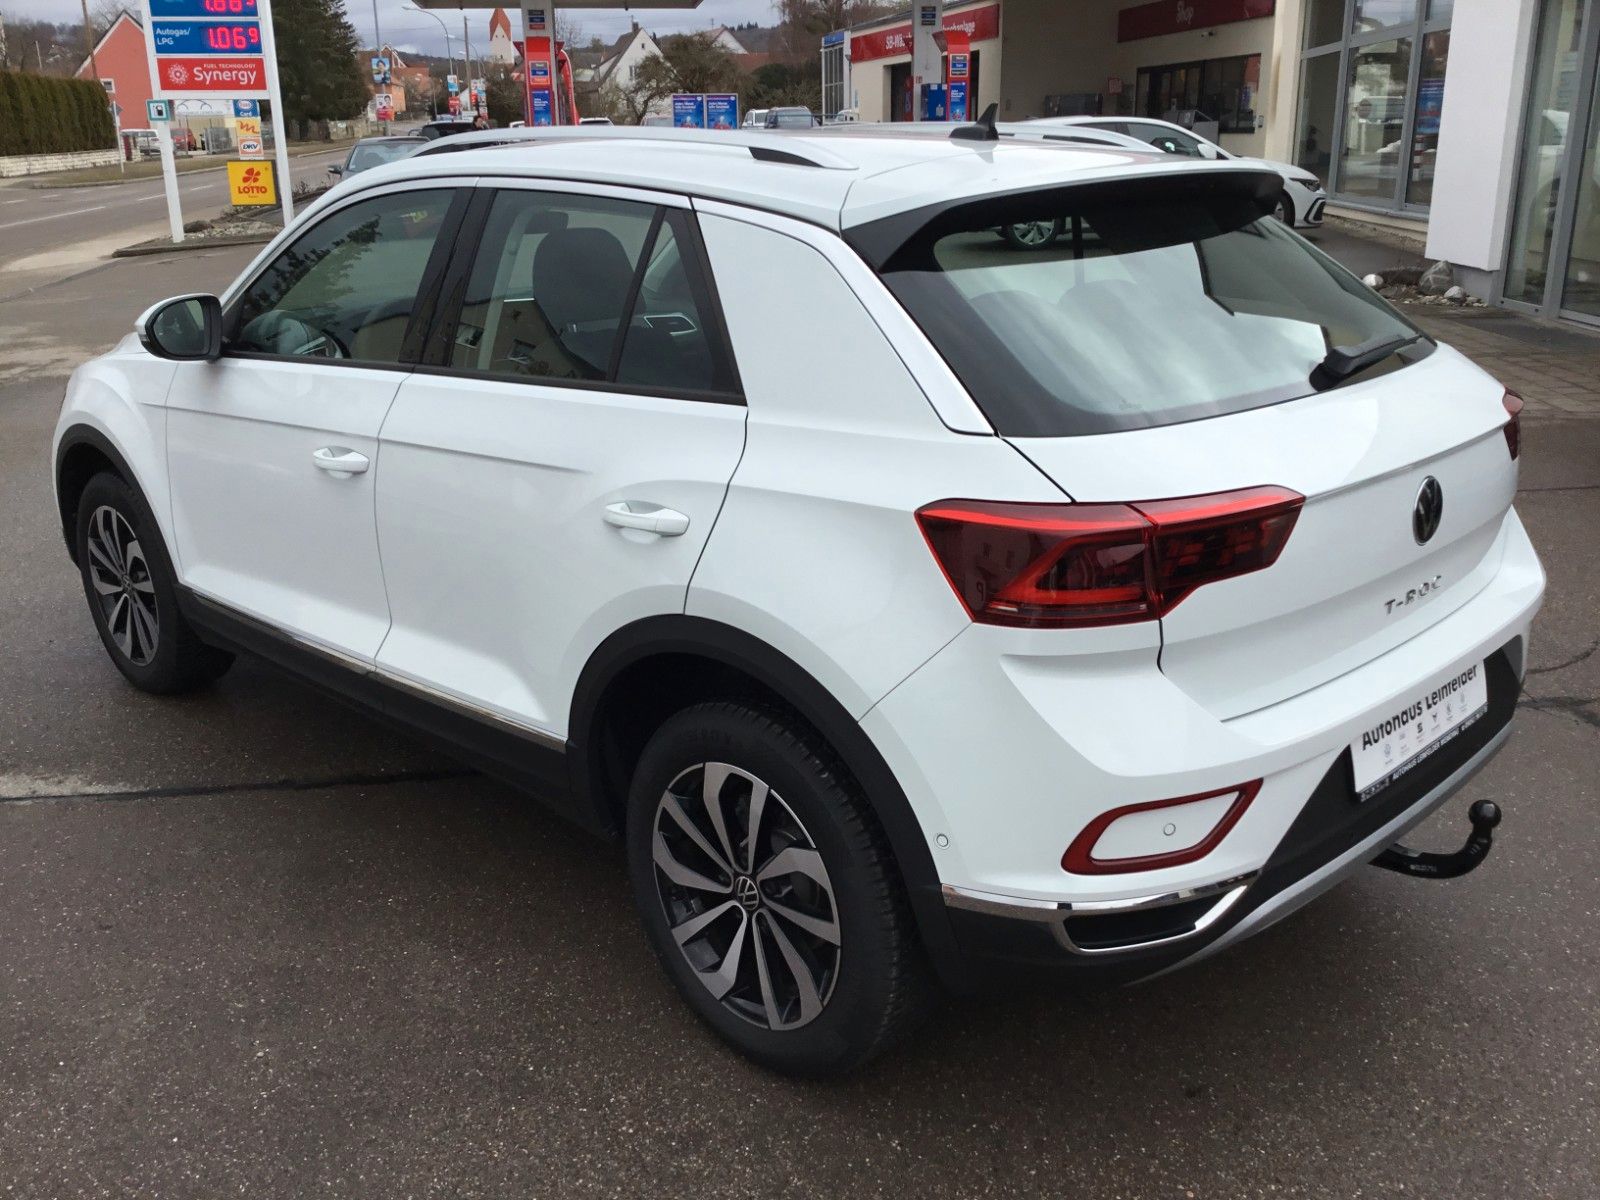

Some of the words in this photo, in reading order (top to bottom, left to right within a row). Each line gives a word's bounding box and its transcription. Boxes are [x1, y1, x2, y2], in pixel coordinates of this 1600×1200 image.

[155, 27, 191, 37] Autogas/
[157, 37, 174, 46] LPG
[193, 66, 257, 86] Synergy
[237, 185, 268, 195] LOTTO
[1384, 575, 1442, 615] T-ROC
